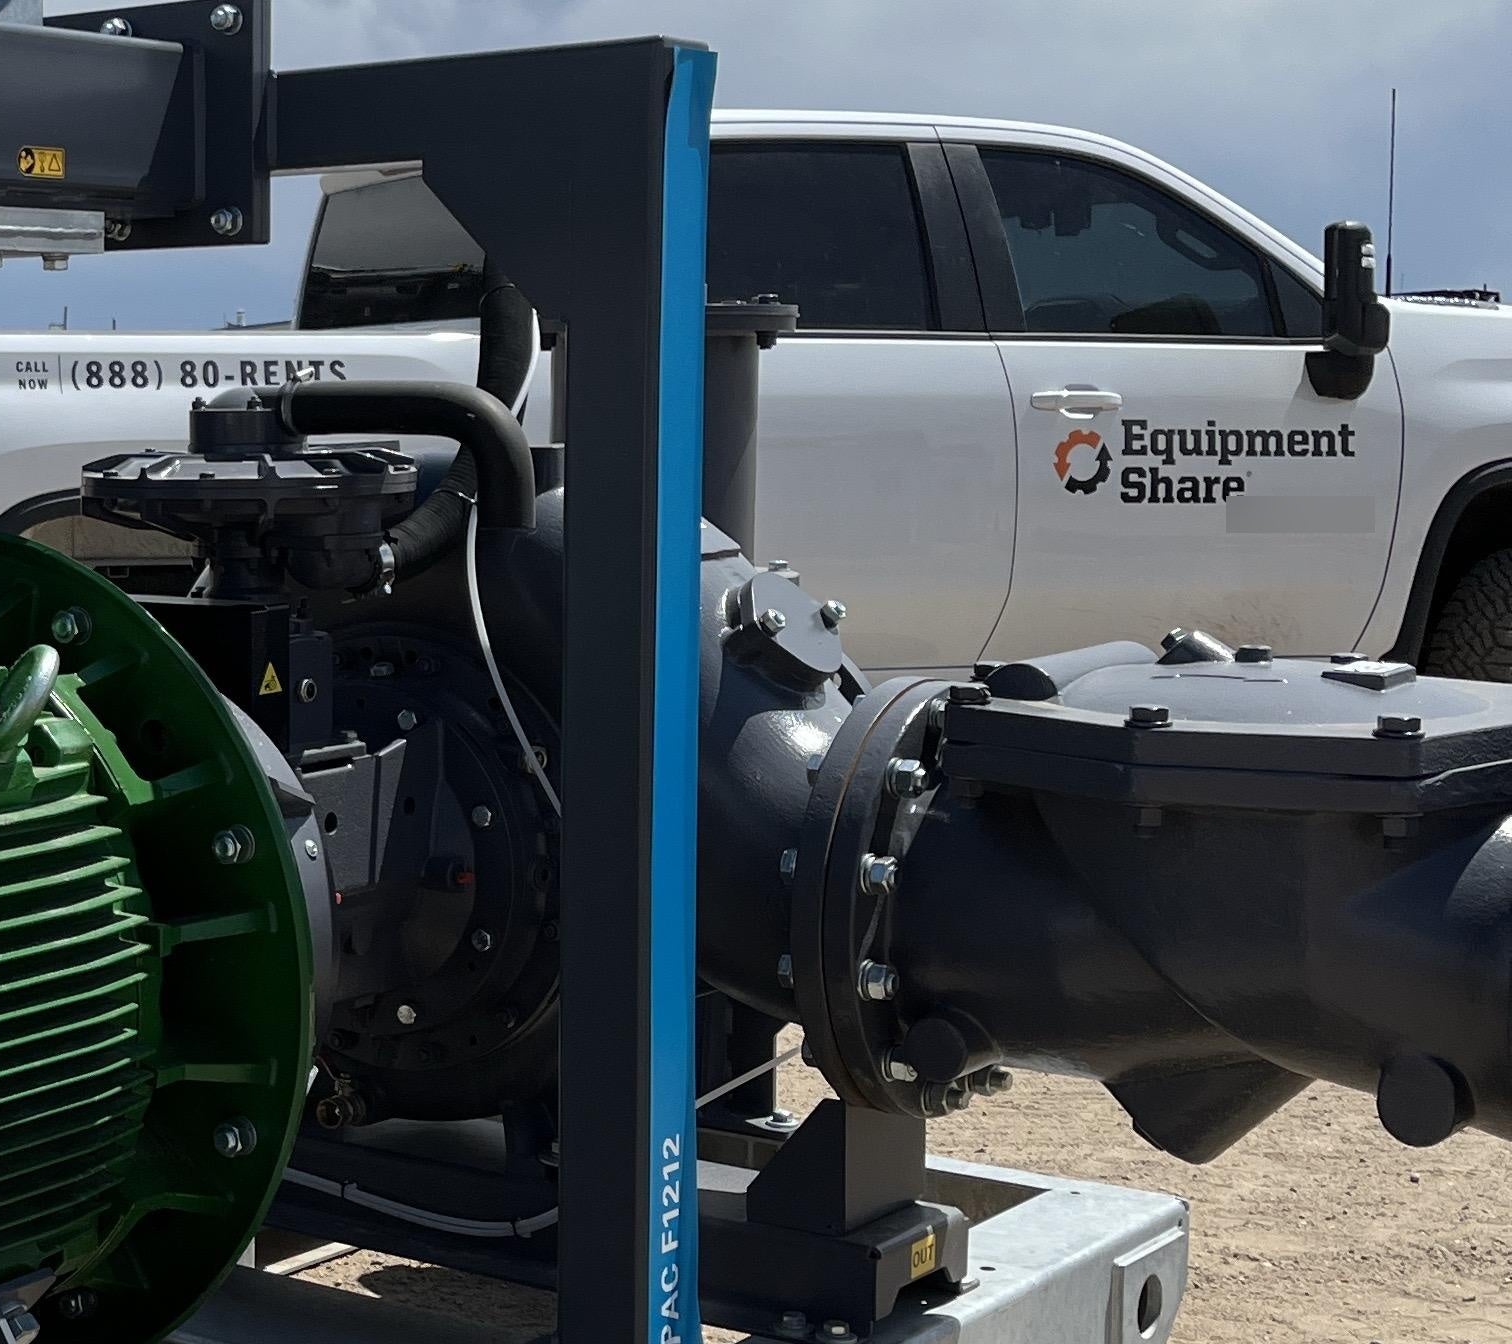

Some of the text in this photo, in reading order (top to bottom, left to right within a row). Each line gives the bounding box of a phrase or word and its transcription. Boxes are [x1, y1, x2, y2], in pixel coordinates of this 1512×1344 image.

[16, 361, 49, 373] CALL
[71, 360, 163, 390] (888)
[18, 378, 49, 390] NOW
[1121, 419, 1356, 465] Equipment
[1120, 467, 1246, 504] Share
[661, 1133, 681, 1254] F1212
[913, 1244, 934, 1268] OUT
